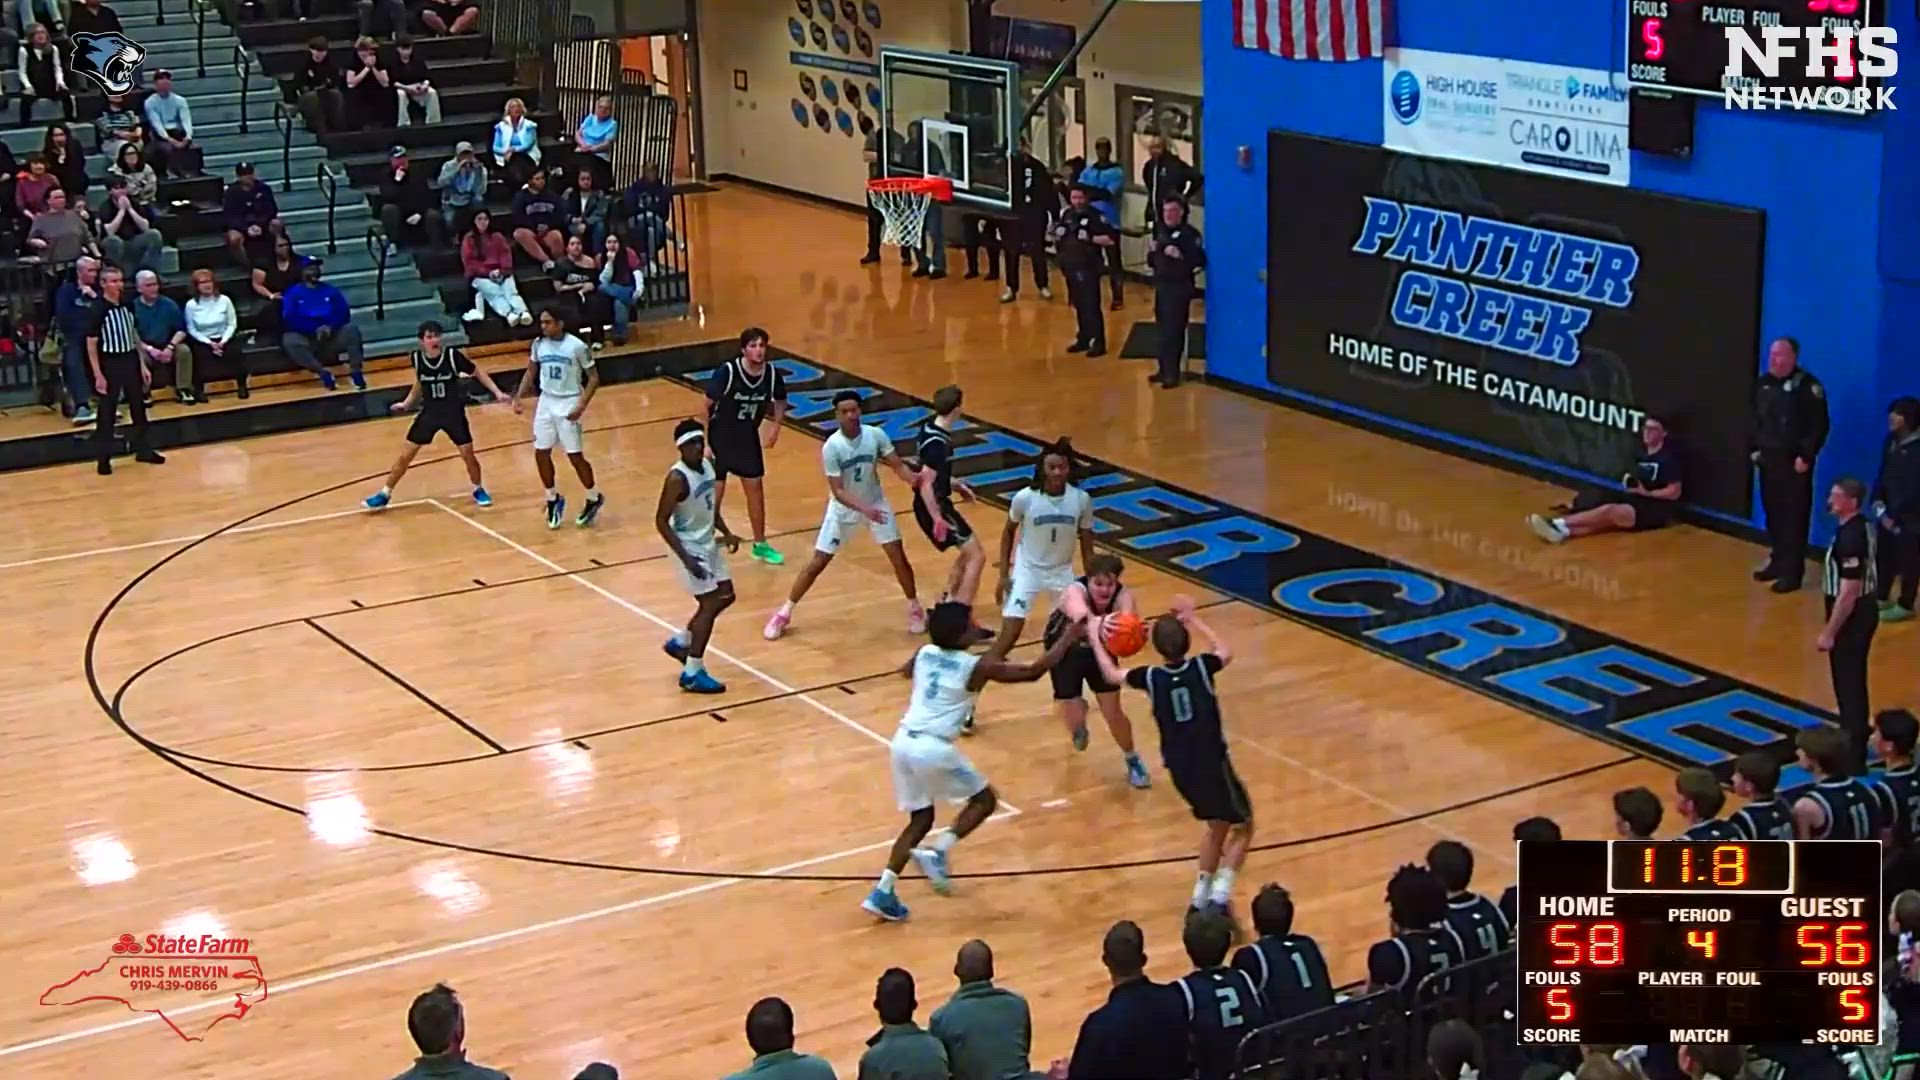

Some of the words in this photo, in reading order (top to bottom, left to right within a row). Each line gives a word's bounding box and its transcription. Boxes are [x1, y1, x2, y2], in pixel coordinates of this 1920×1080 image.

[1633, 1, 1667, 17] FOULS
[1703, 6, 1744, 25] PLAYER
[1753, 11, 1782, 27] FOUL
[1642, 20, 1664, 59] 5
[1426, 75, 1454, 93] HIGH
[1456, 79, 1498, 99] HOUSE
[1631, 64, 1666, 82] SCORE
[1583, 83, 1626, 103] FAMILY
[1510, 119, 1624, 161] CAROLINA
[1353, 196, 1640, 308] PANTHER
[1391, 270, 1592, 366] CREEK
[550, 366, 562, 379] 12
[1329, 333, 1393, 368] HOME
[1400, 351, 1428, 376] OF
[1433, 360, 1477, 390] THE
[1483, 373, 1645, 433] CATAMOUNT
[431, 382, 446, 399] 10
[738, 403, 758, 420] 24
[1172, 687, 1193, 723] 0
[1291, 951, 1312, 989] 1
[1215, 987, 1243, 1028] 2
